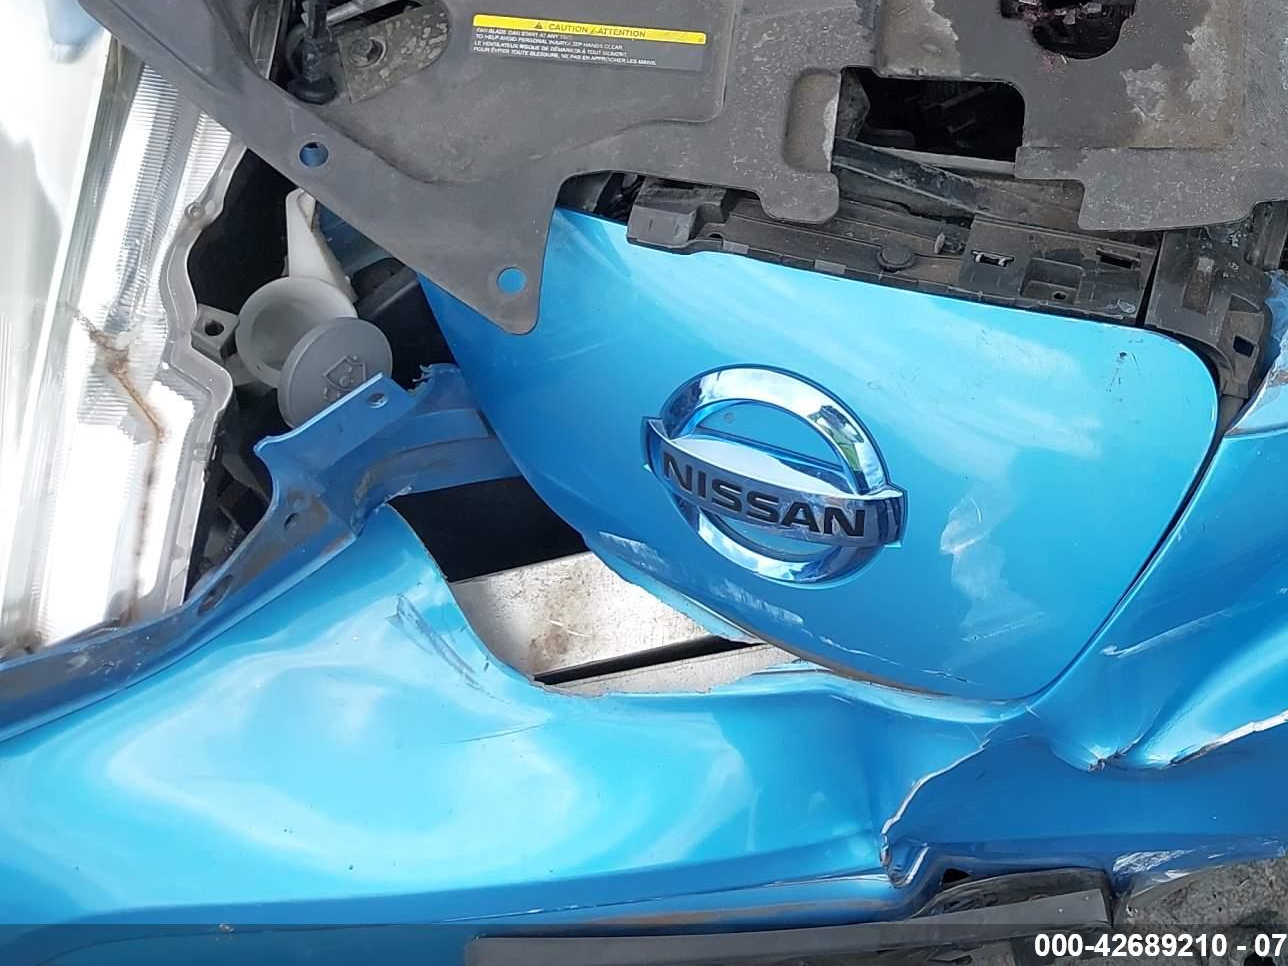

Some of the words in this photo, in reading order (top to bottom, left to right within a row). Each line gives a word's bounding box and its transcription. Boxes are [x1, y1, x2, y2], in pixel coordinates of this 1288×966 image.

[549, 23, 588, 33] CAUTION
[598, 27, 646, 37] ATTENTION
[662, 453, 867, 538] NISSAN
